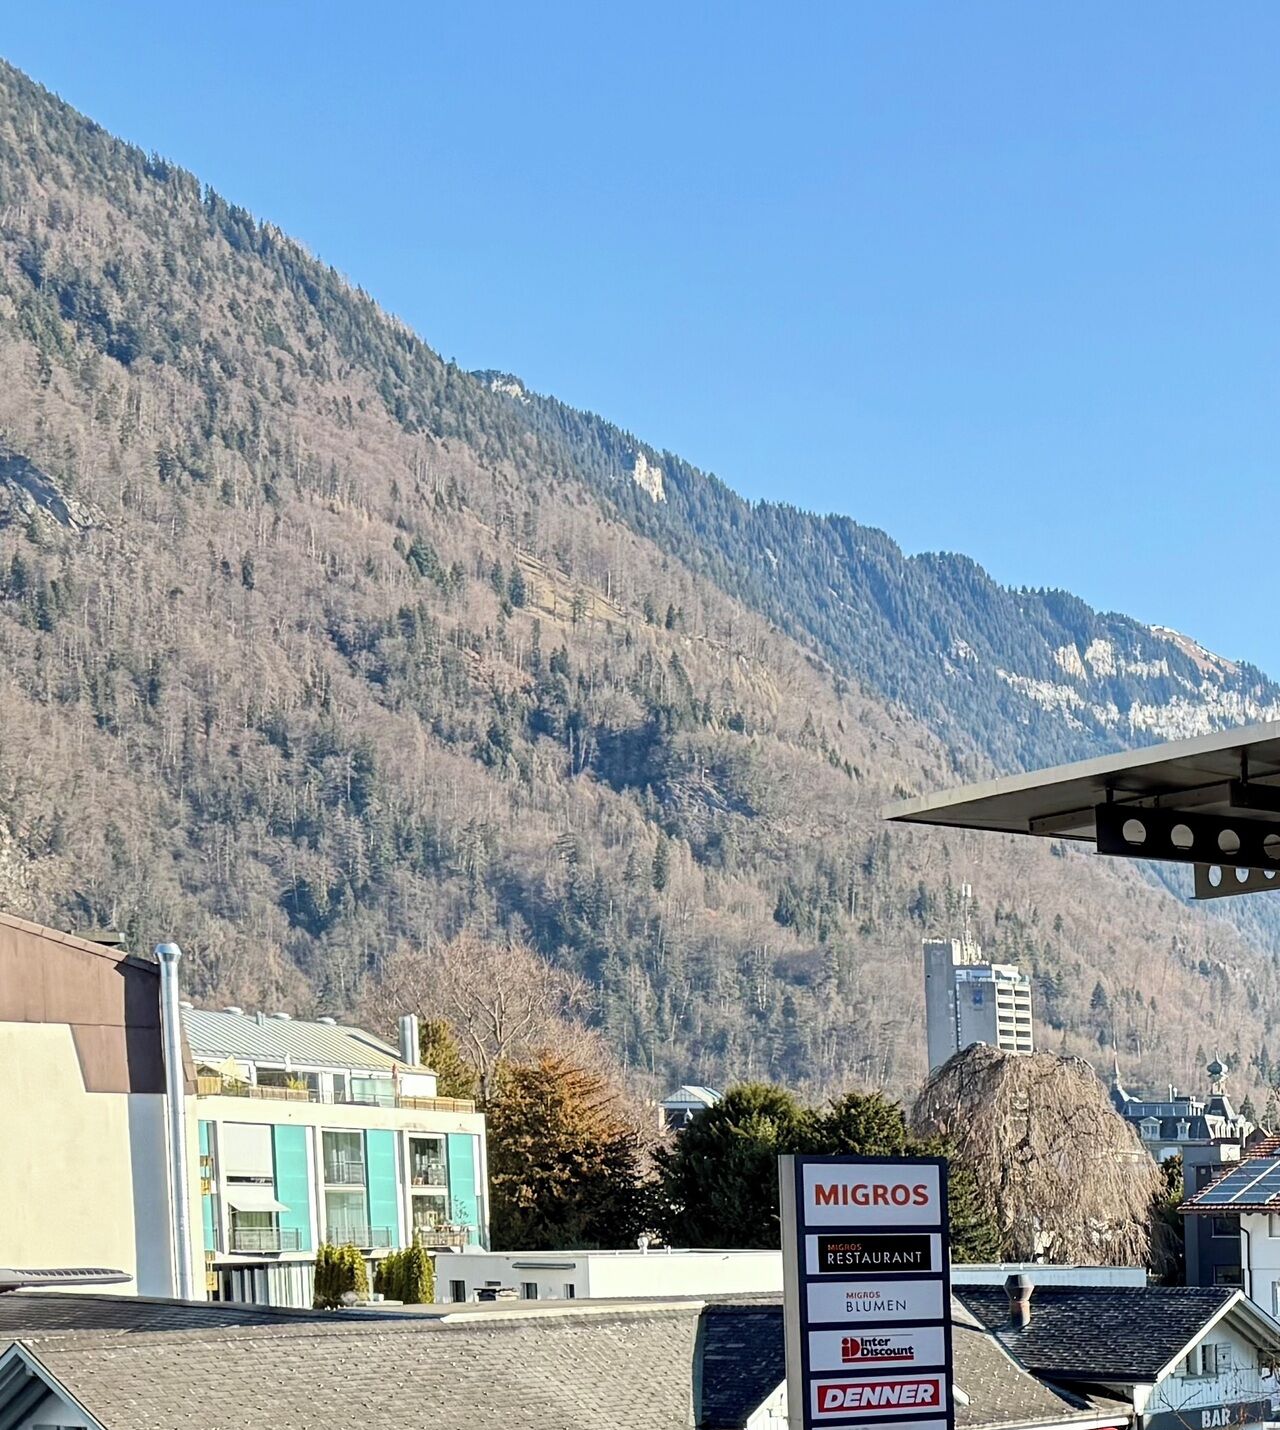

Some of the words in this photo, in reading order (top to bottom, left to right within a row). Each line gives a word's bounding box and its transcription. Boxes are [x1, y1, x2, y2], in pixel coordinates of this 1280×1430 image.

[814, 1183, 929, 1206] MIGROS
[827, 1243, 862, 1251] MIGROS
[827, 1251, 922, 1265] RESTAURANT
[846, 1291, 881, 1299] MIGROS
[846, 1300, 907, 1313] BLUMEN
[860, 1337, 891, 1347] Inter
[860, 1345, 914, 1357] Discount
[823, 1384, 935, 1409] DENNER
[1201, 1408, 1231, 1429] BAR
